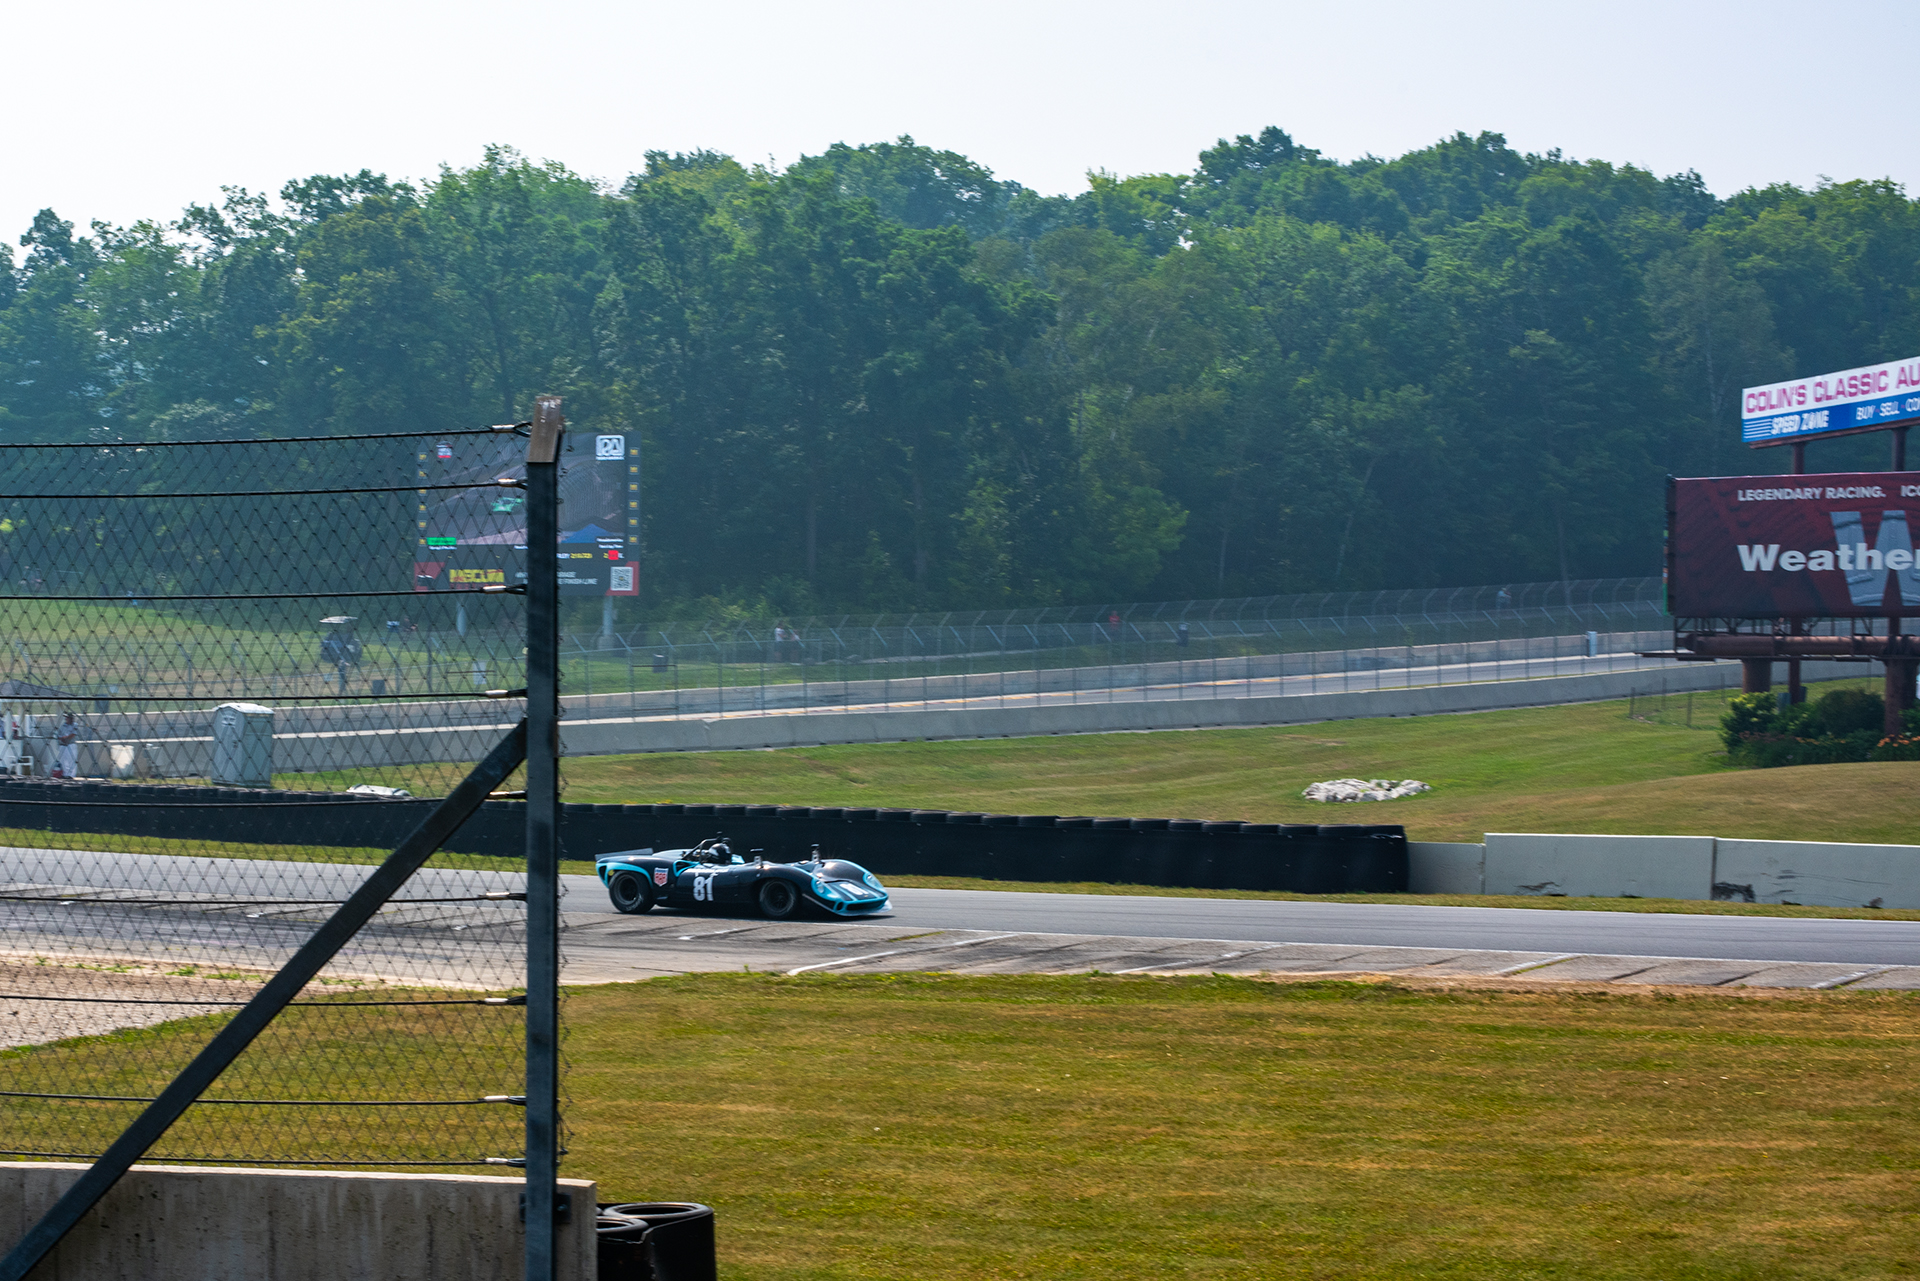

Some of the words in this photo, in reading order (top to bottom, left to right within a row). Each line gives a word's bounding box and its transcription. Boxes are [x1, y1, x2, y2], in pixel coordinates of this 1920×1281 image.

[1745, 384, 1807, 414] COLIN'S
[1814, 369, 1889, 403] CLASSIC
[1737, 486, 1824, 502] LEGENDARY
[1825, 485, 1887, 499] RACING.
[693, 876, 714, 901] 81
